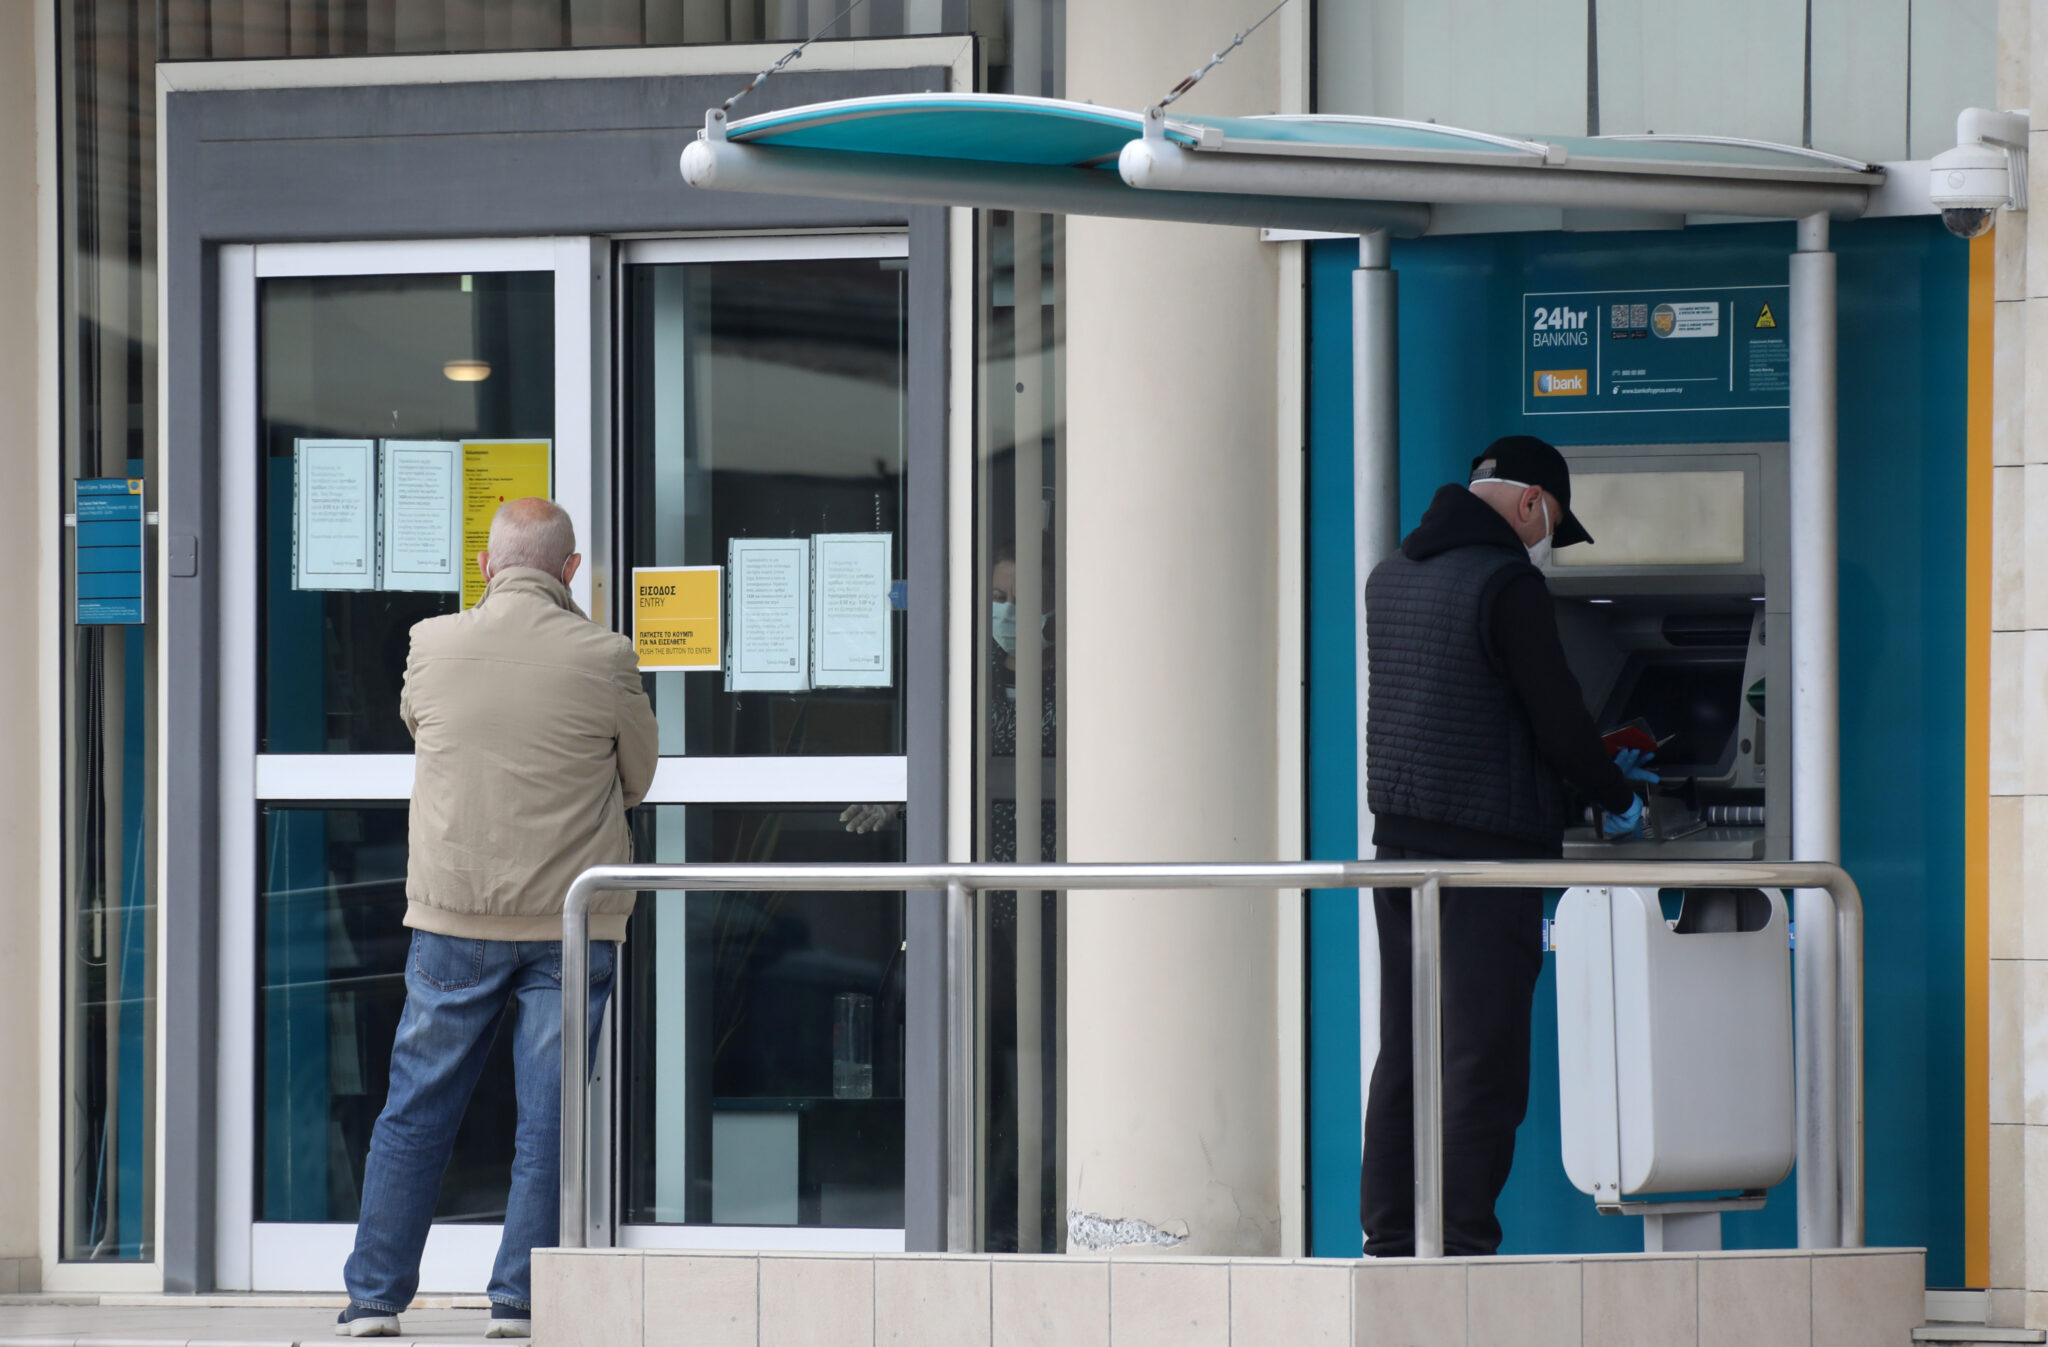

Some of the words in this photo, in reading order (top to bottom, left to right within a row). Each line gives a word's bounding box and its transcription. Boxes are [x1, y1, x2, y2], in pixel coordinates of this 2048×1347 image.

[1533, 306, 1588, 330] 24hr
[1533, 331, 1588, 347] BANKING
[640, 586, 676, 596] ΕΙΣΟΔΟΣ
[640, 597, 665, 607] ENTRY
